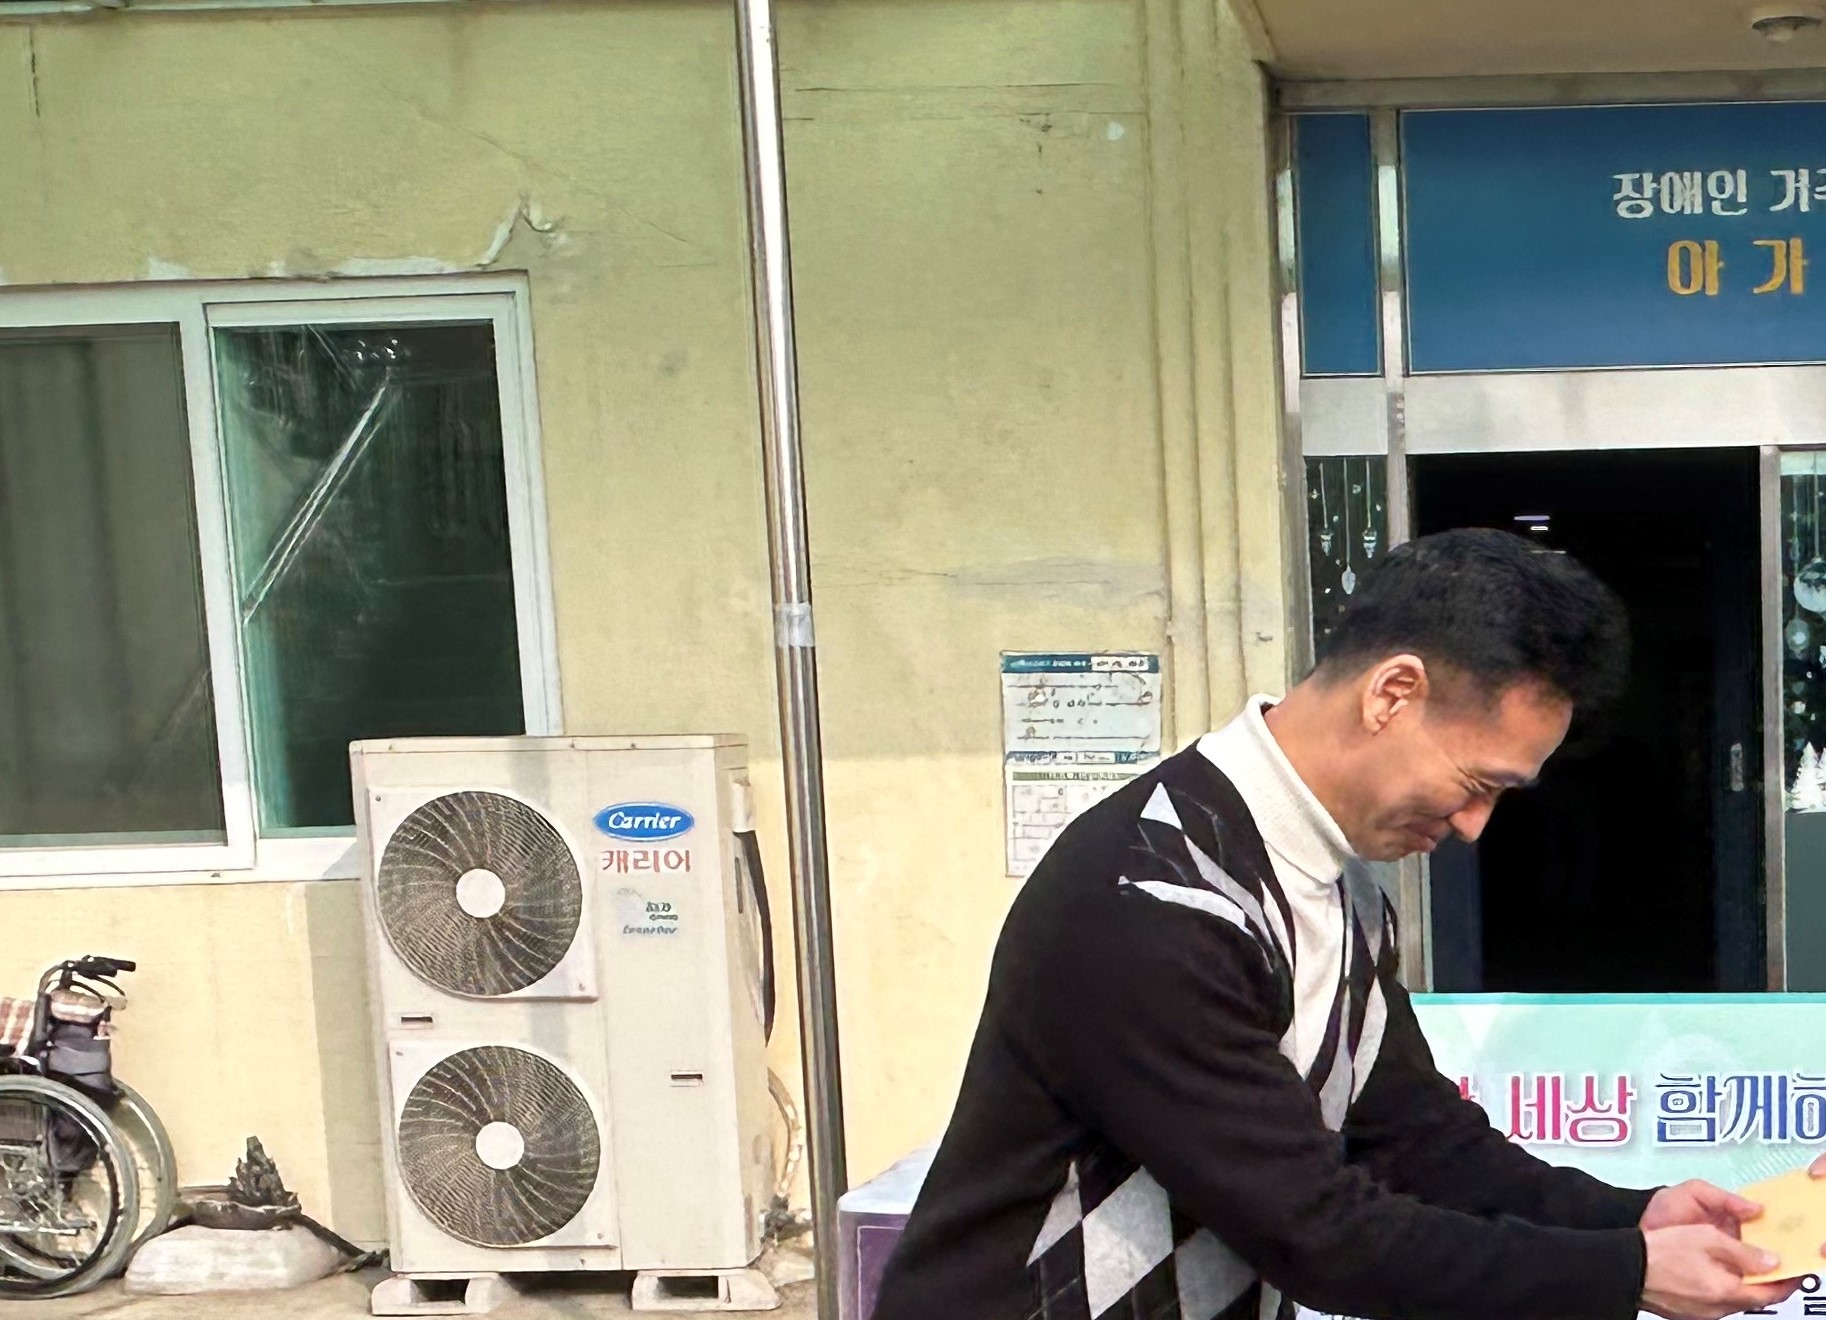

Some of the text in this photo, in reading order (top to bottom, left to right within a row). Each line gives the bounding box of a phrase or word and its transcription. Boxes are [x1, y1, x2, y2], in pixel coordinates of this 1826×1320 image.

[1613, 170, 1749, 220] 장애인
[608, 811, 682, 830] Carrier
[602, 849, 691, 873] 캐리어
[1508, 1074, 1636, 1143] 세상
